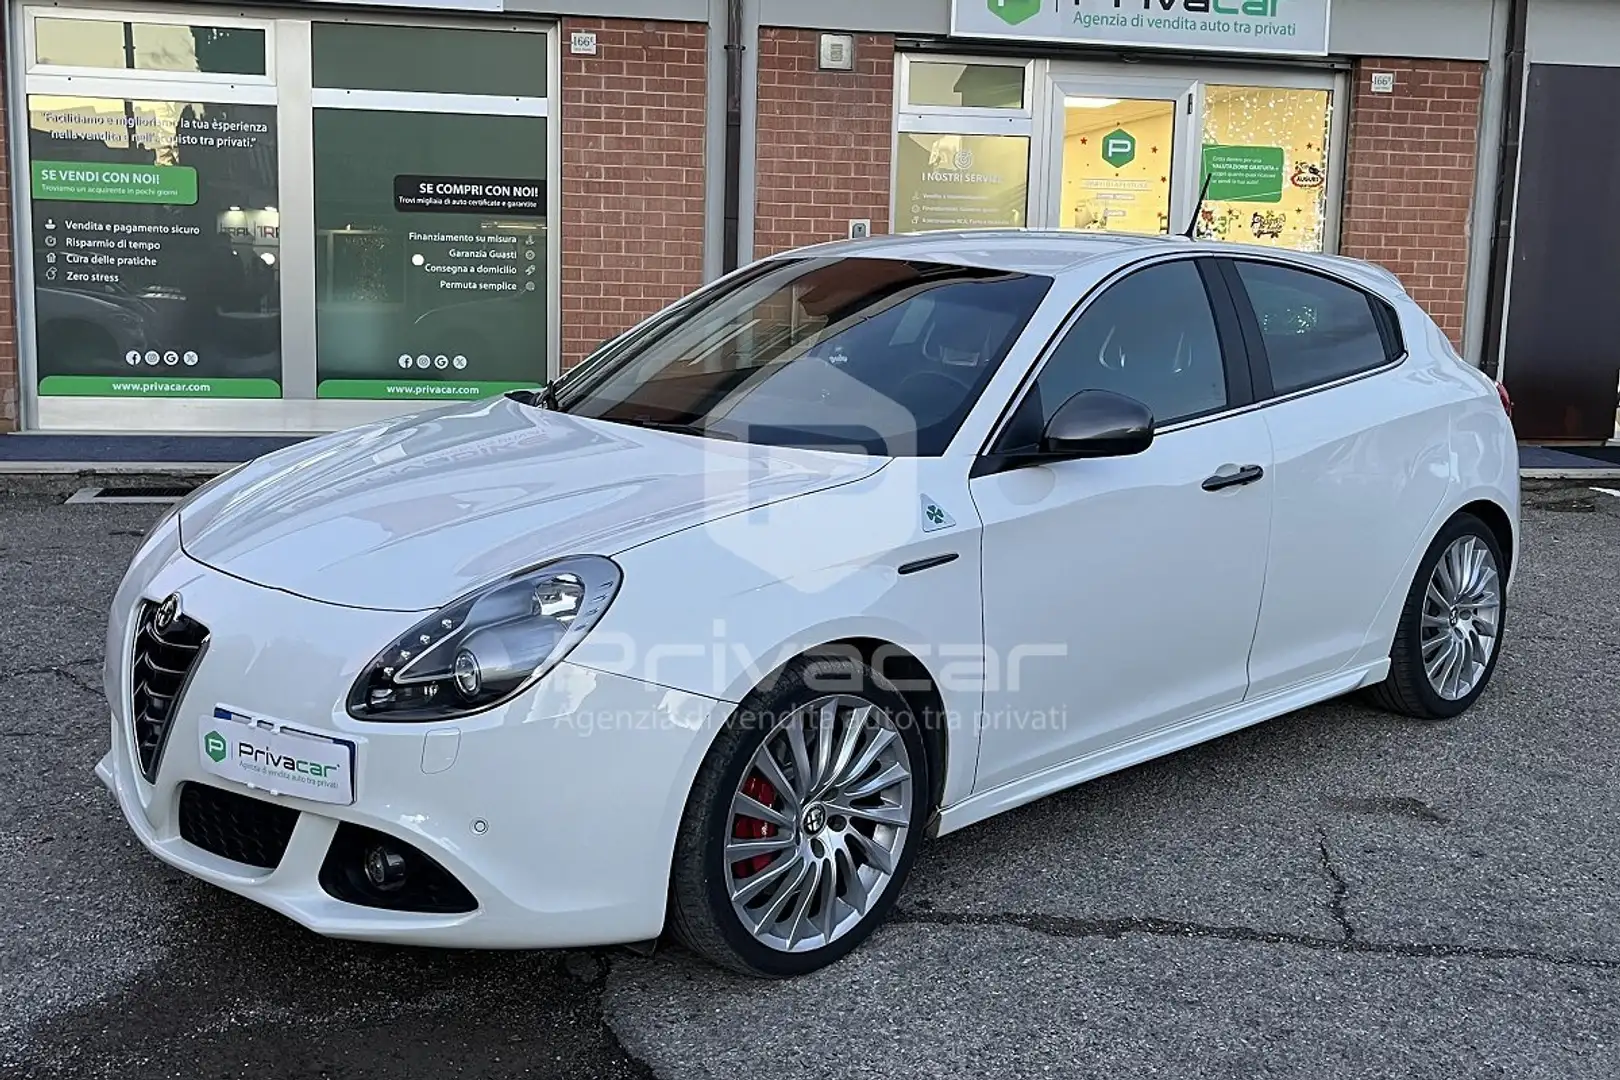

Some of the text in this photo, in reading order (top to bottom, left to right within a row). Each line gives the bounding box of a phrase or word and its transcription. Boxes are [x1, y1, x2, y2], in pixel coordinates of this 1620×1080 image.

[1073, 11, 1296, 36] Agenzia di vendita auto tra privati
[181, 117, 190, 128] la
[192, 118, 209, 129] tua
[50, 130, 77, 139] nella
[78, 131, 122, 141] vendita
[200, 136, 214, 146] tra
[41, 169, 57, 180] SE
[59, 170, 99, 182] VENDI
[102, 172, 129, 183] CON
[927, 172, 962, 182] NOSTRI
[41, 183, 75, 193] Troviamo
[87, 185, 126, 195] acquirente
[127, 186, 135, 195] in
[135, 187, 155, 197] pochi
[157, 188, 178, 197] giorni
[419, 183, 539, 197] SE COMPRI CON NOI!
[399, 195, 416, 204] Trovi
[416, 196, 442, 206] migliaia
[444, 197, 451, 205] di
[468, 198, 500, 207] certificate
[507, 200, 537, 209] garantite
[65, 220, 200, 235] Vendita e pagamento sicuro
[65, 237, 161, 251] Risparmio di tempo
[408, 232, 474, 242] Finanziamento
[487, 234, 517, 243] misura
[66, 253, 157, 267] Cura delle pratiche
[448, 248, 517, 259] Garanzia Guasti
[424, 263, 468, 275] Consegna
[476, 264, 517, 274] domicilio
[66, 271, 119, 282] Zero stress
[439, 280, 517, 292] Permuta semplice
[112, 381, 211, 393] www.privacar.com
[386, 384, 480, 395] www.privacar.com
[239, 742, 337, 778] Privacar
[307, 776, 316, 785] tra
[317, 779, 339, 789] privati
